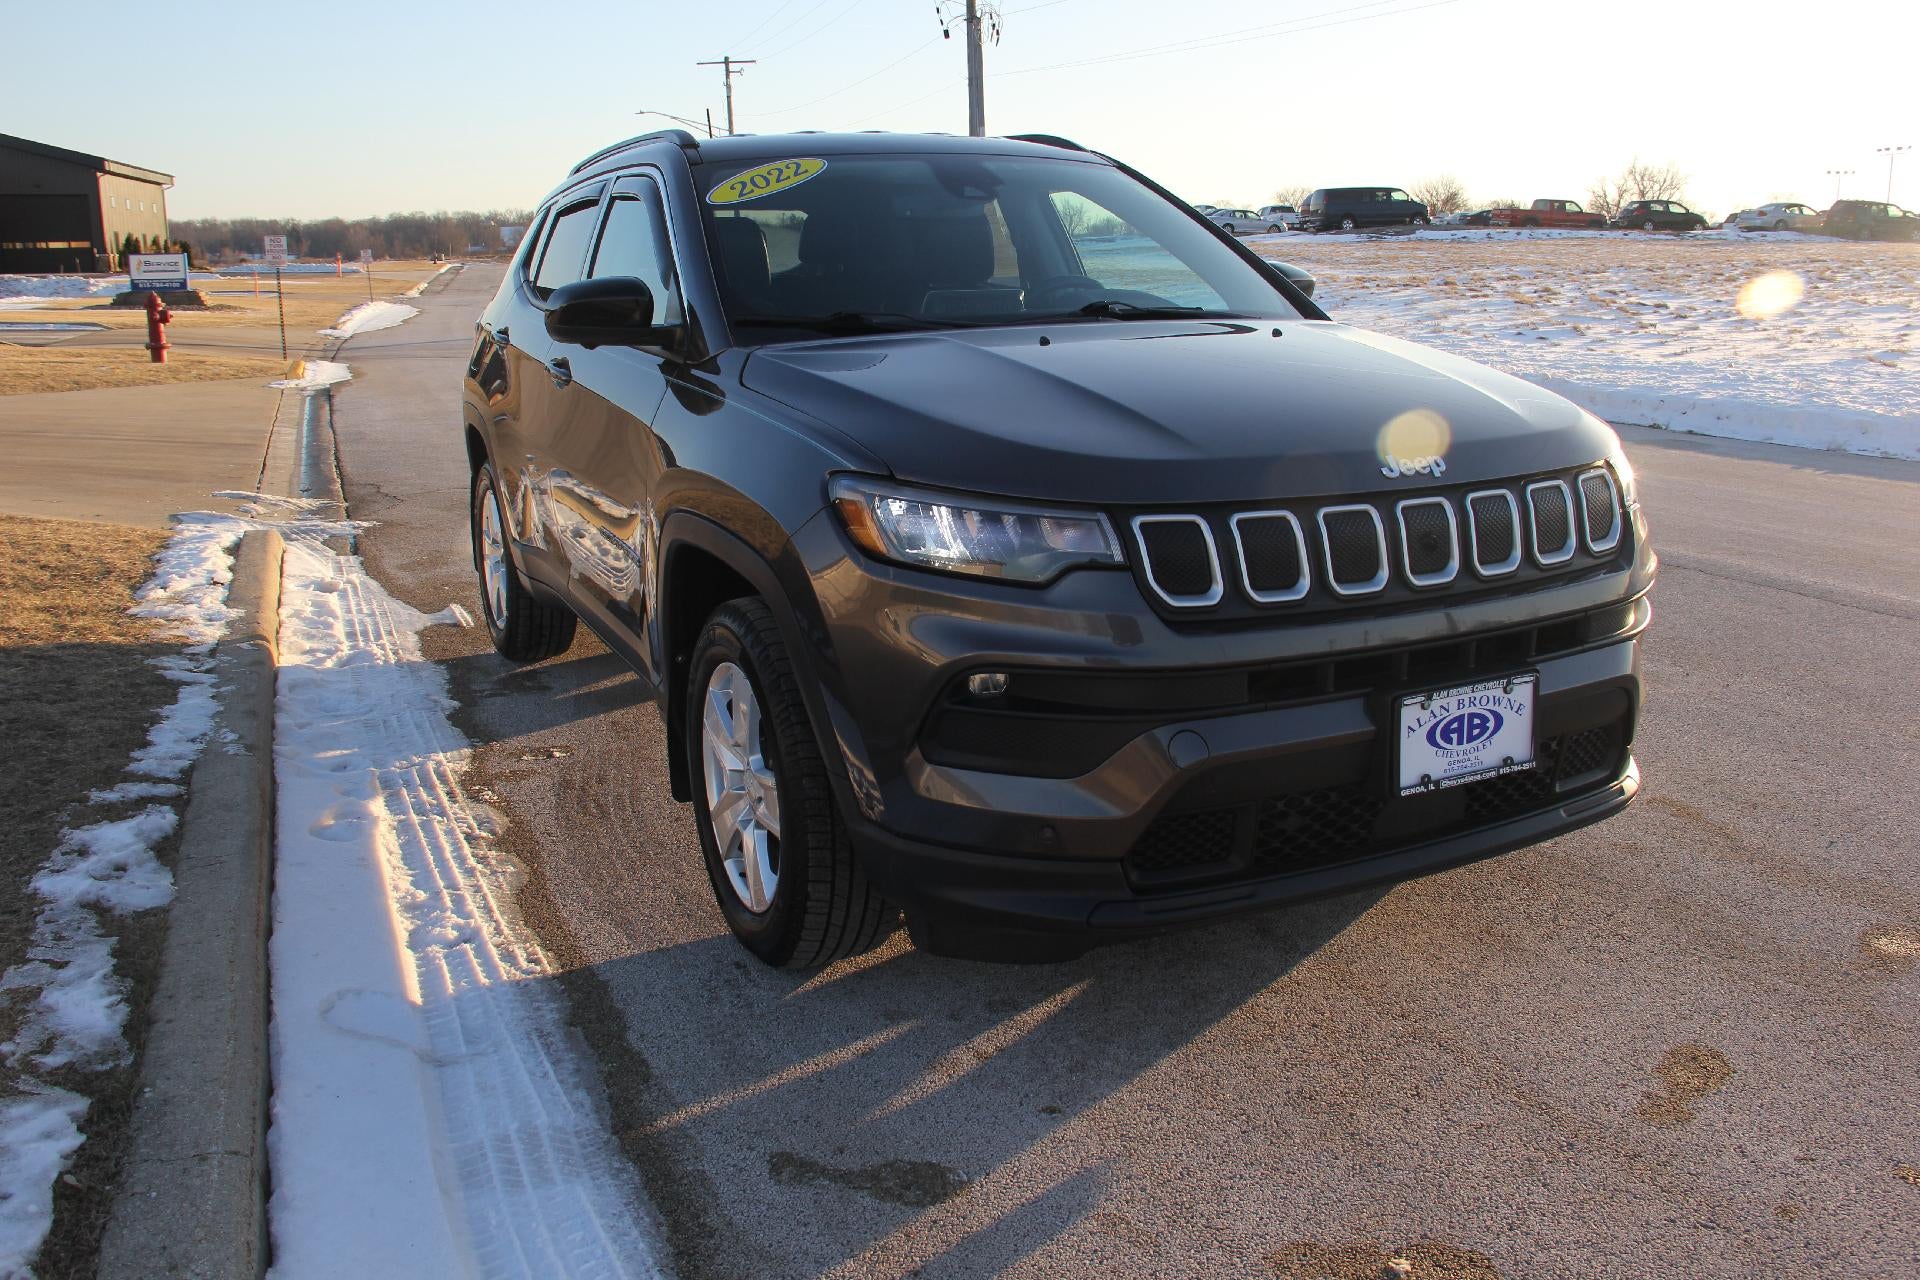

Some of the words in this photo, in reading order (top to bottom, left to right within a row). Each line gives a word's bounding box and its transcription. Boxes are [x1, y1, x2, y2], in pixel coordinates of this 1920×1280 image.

[729, 161, 809, 199] 2022
[1380, 454, 1447, 479] Jeep
[1431, 689, 1449, 701] ALAN
[1448, 685, 1474, 698] BROWNE
[1473, 679, 1509, 693] CHEVROLET
[1405, 701, 1451, 739] ALAN
[1456, 694, 1528, 717] BROWNE
[1439, 711, 1491, 746] AB
[1434, 738, 1494, 760] CHEVROLET
[1447, 756, 1473, 768] GENOA,
[1400, 784, 1428, 797] GENOA,
[1428, 782, 1436, 791] IL
